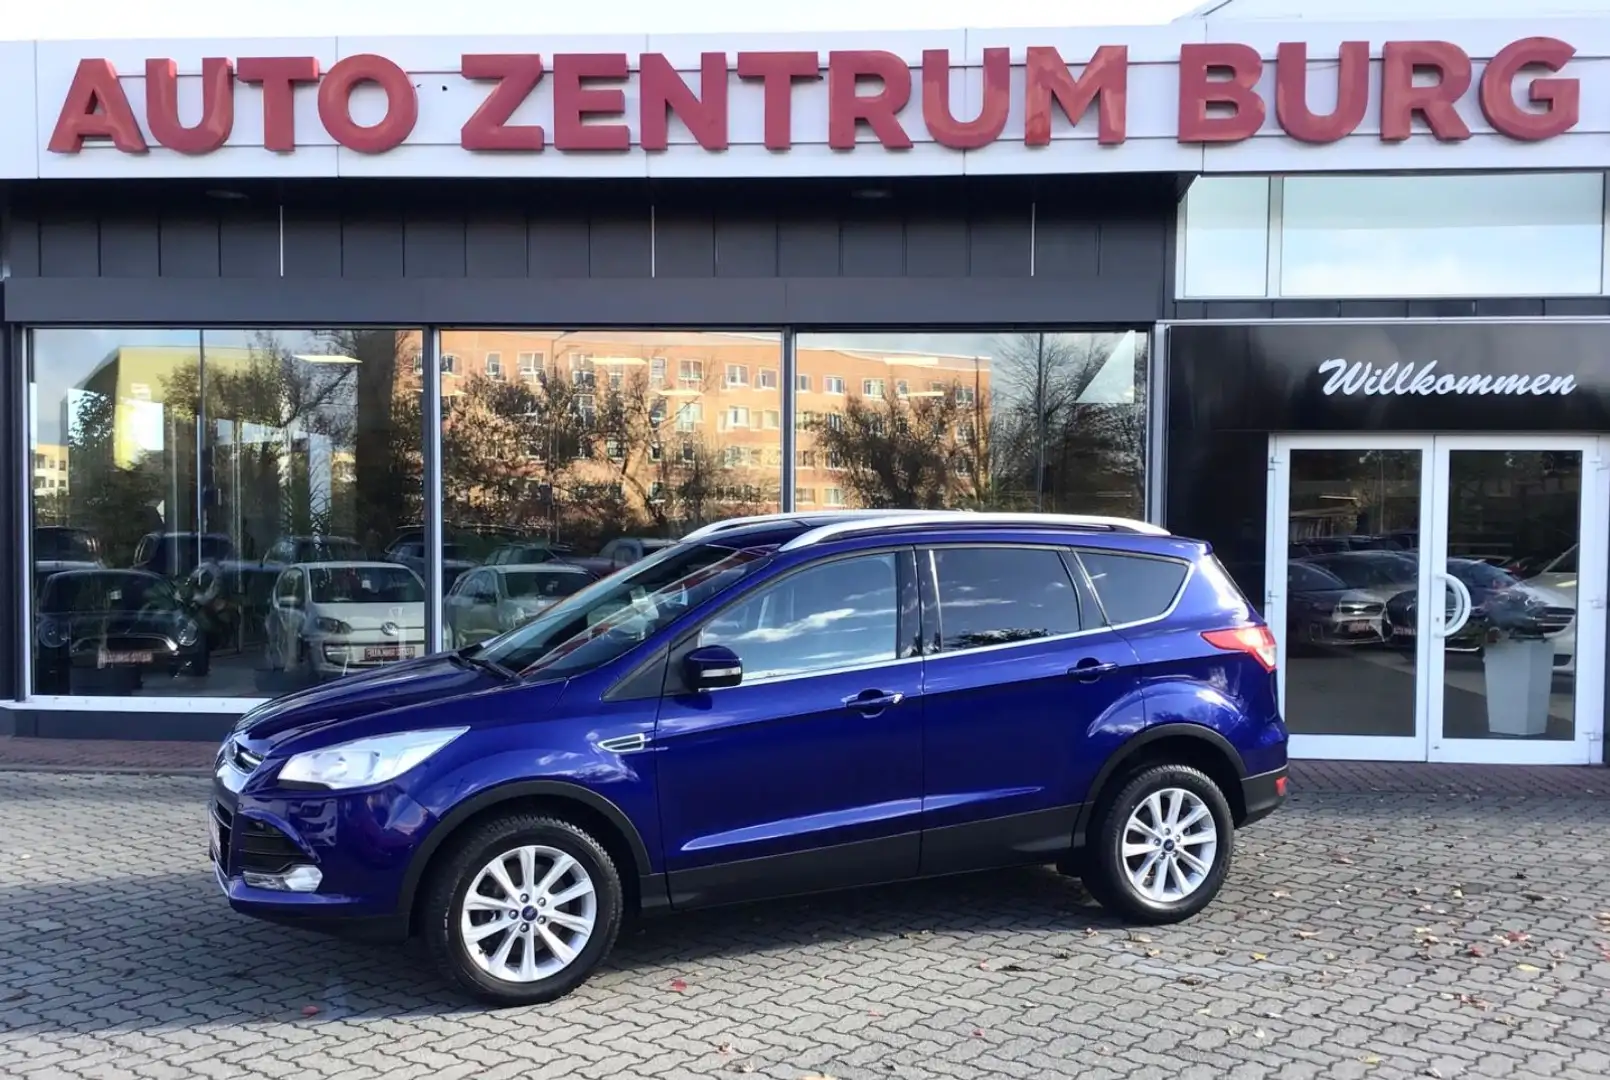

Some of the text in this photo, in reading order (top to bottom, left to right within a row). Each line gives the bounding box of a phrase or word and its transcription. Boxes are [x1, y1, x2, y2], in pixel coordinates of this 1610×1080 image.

[48, 36, 1580, 154] AUTO ZENTRUM BURG
[1318, 358, 1577, 396] Willkommen
